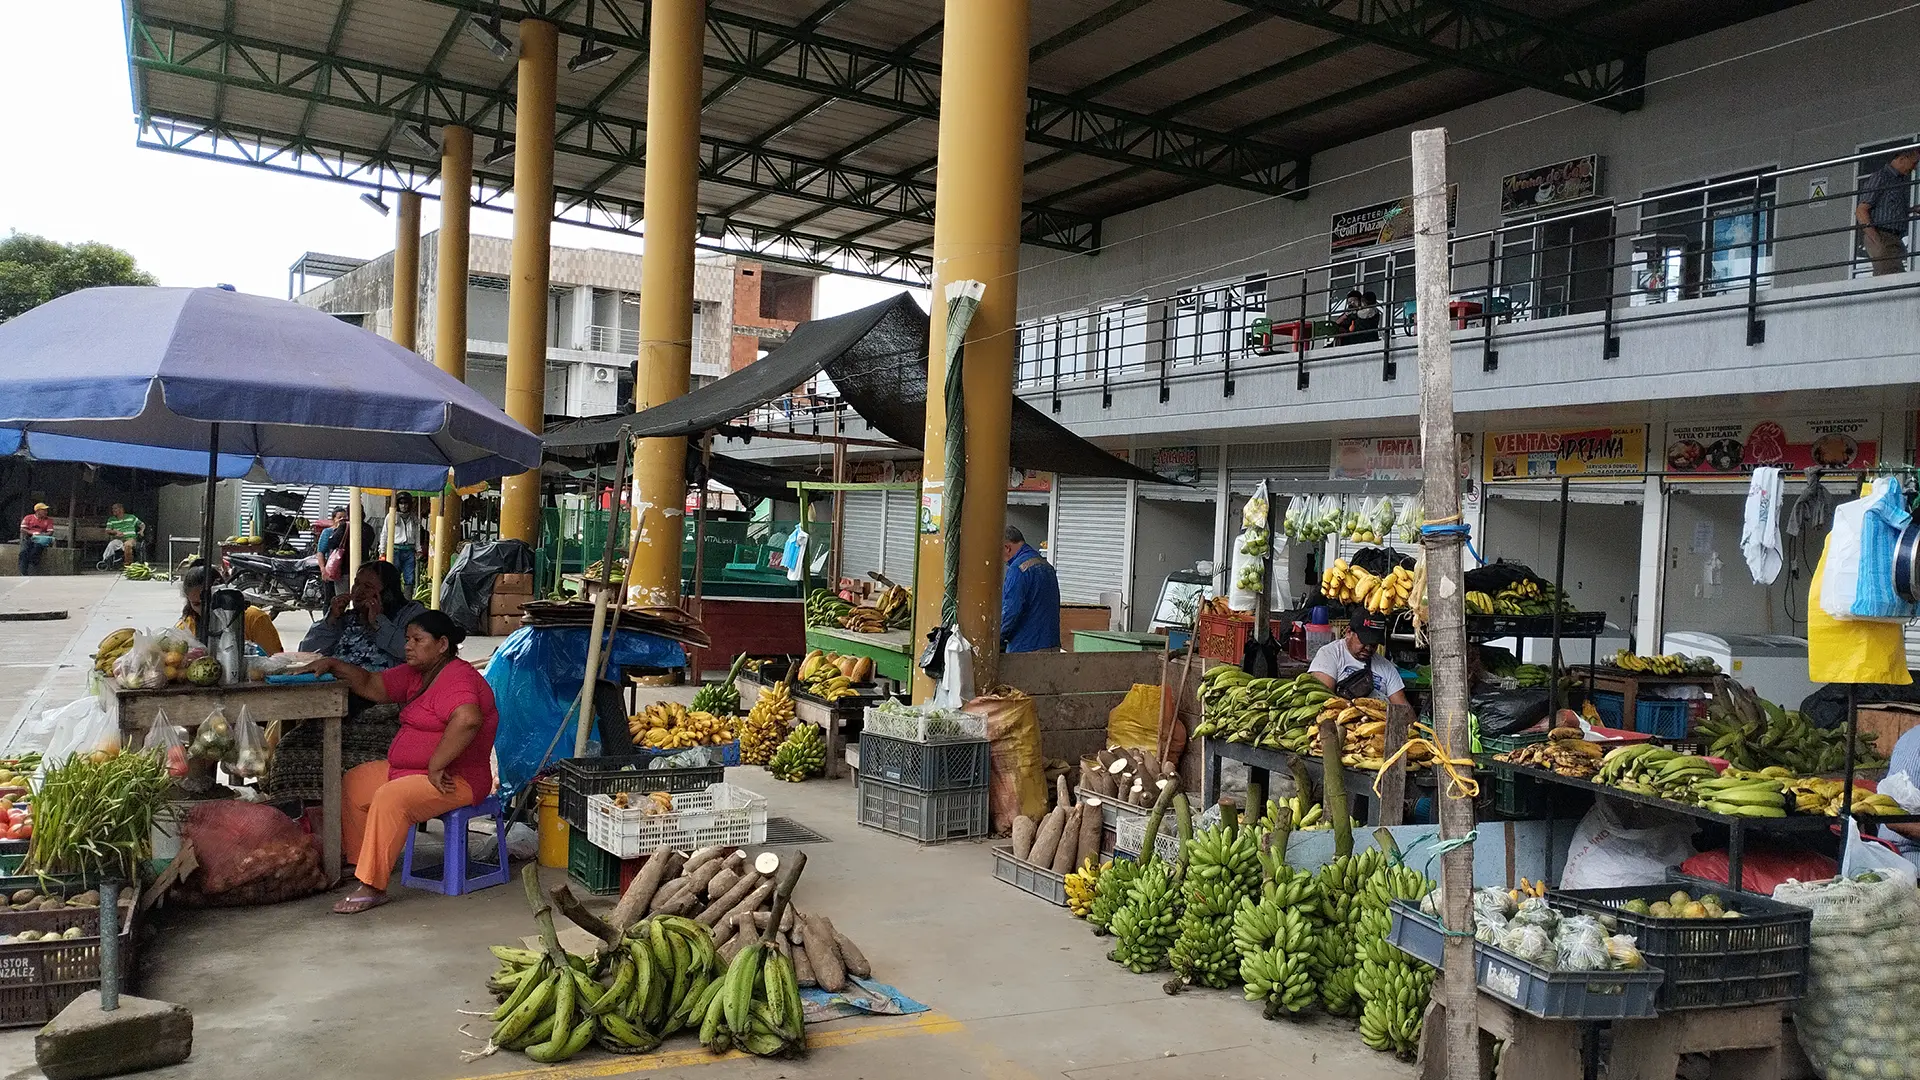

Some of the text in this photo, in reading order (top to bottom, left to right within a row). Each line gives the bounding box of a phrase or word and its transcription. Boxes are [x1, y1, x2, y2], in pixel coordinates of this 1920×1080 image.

[1376, 440, 1414, 456] VENTA
[1494, 432, 1561, 453] VENTAS
[1556, 437, 1624, 463] ADRIANA
